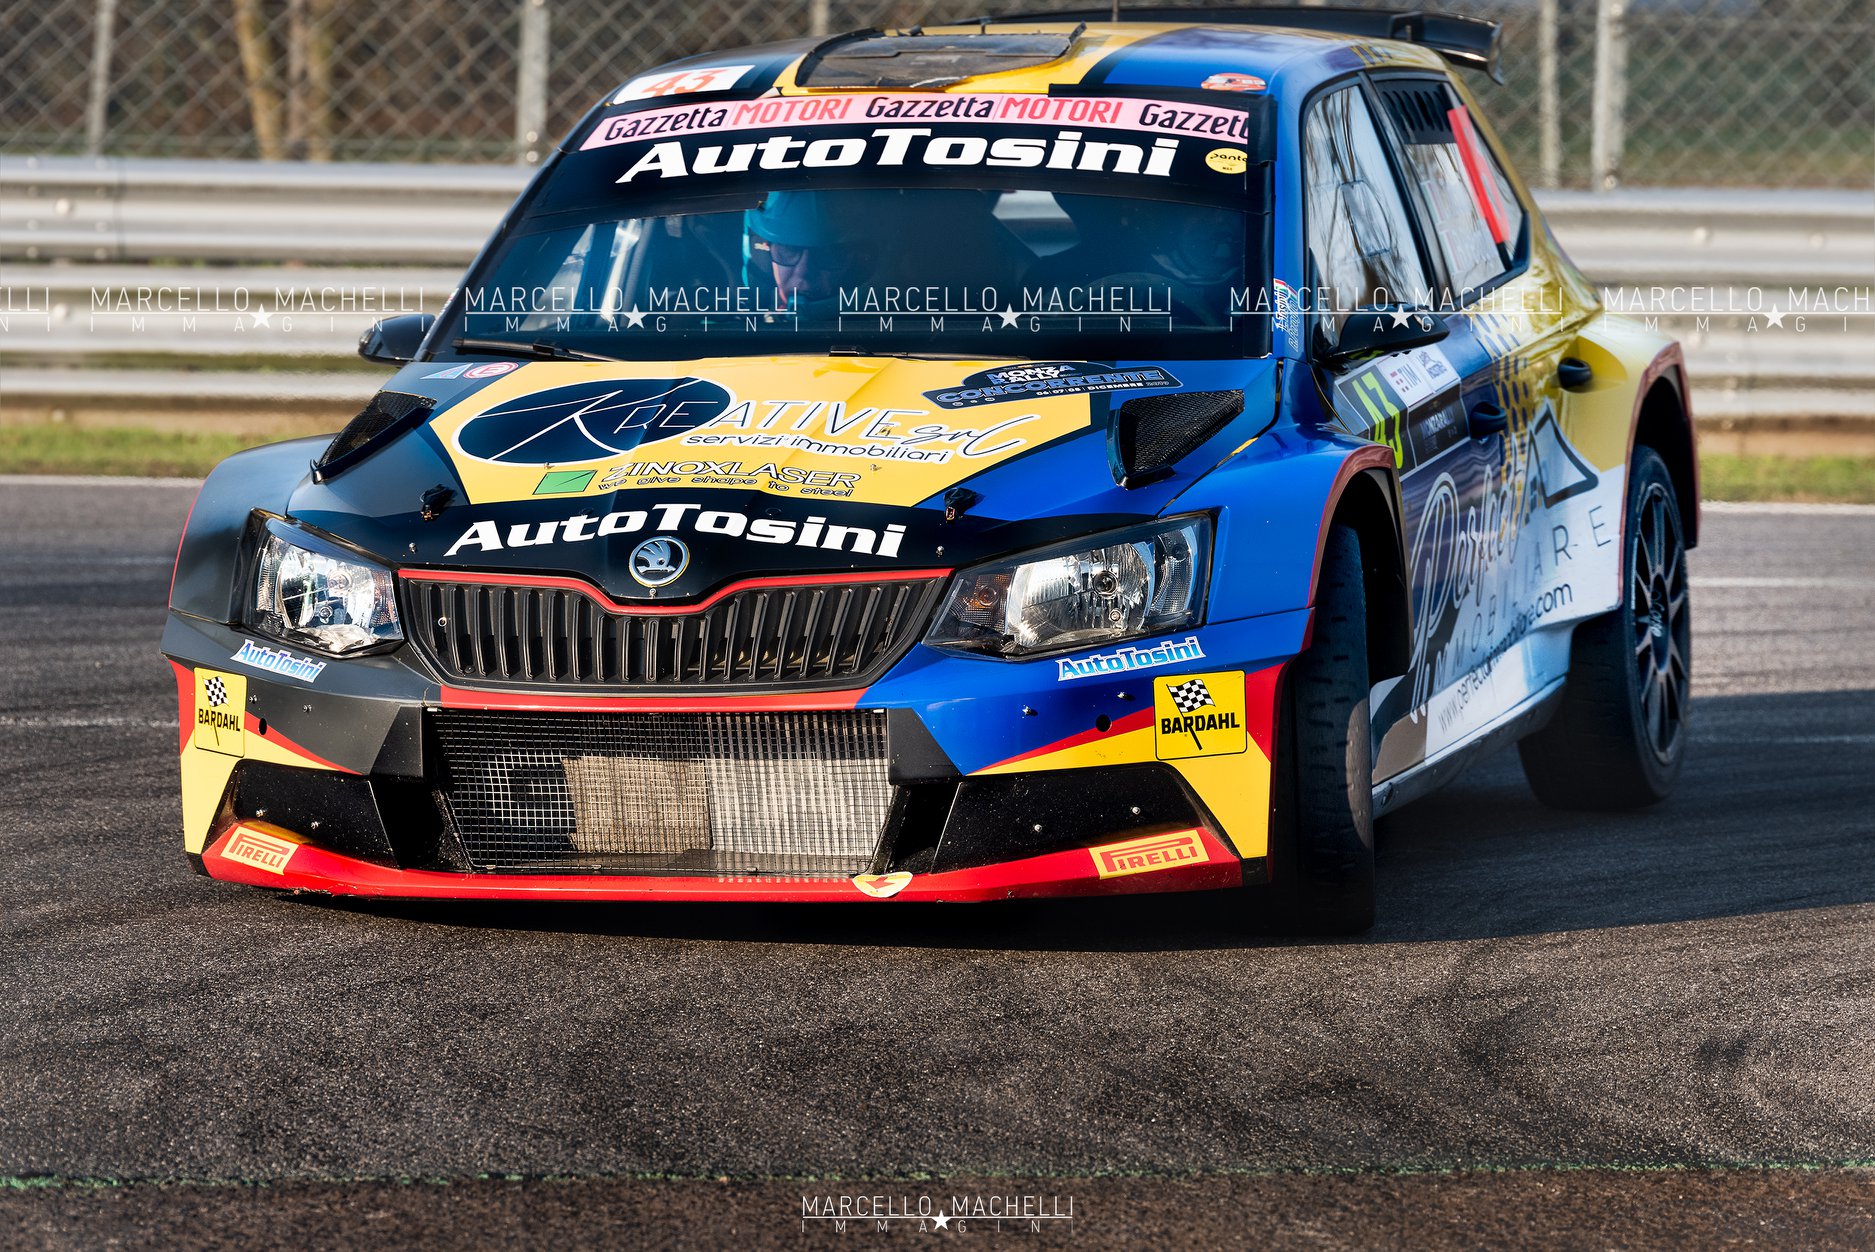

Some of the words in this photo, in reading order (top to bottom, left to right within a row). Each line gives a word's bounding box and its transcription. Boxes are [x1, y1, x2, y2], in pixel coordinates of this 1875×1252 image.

[641, 69, 729, 97] 43
[605, 108, 728, 141] Gazzetta
[732, 98, 853, 126] MOTORI
[865, 97, 995, 118] Gazzetta
[1001, 97, 1124, 124] MOTORI
[615, 128, 1180, 184] AutoTosini
[936, 369, 1166, 402] CONCORRENTE
[986, 364, 1077, 381] MONZA
[686, 432, 782, 446] servizi
[790, 433, 949, 462] immobiliari
[602, 461, 861, 489] ZINOXLASER
[636, 475, 682, 486] give
[692, 475, 758, 486] shape
[768, 480, 790, 491] to
[800, 486, 853, 498] steel
[442, 503, 908, 558] AutoTosini
[231, 639, 327, 683] AutoTosini
[1056, 636, 1206, 681] AutoTosini
[198, 708, 241, 732] BARDAHL
[1161, 712, 1240, 735] BARDAHL
[228, 833, 290, 868] PIRELLI
[1099, 836, 1198, 873] PIRELLI
